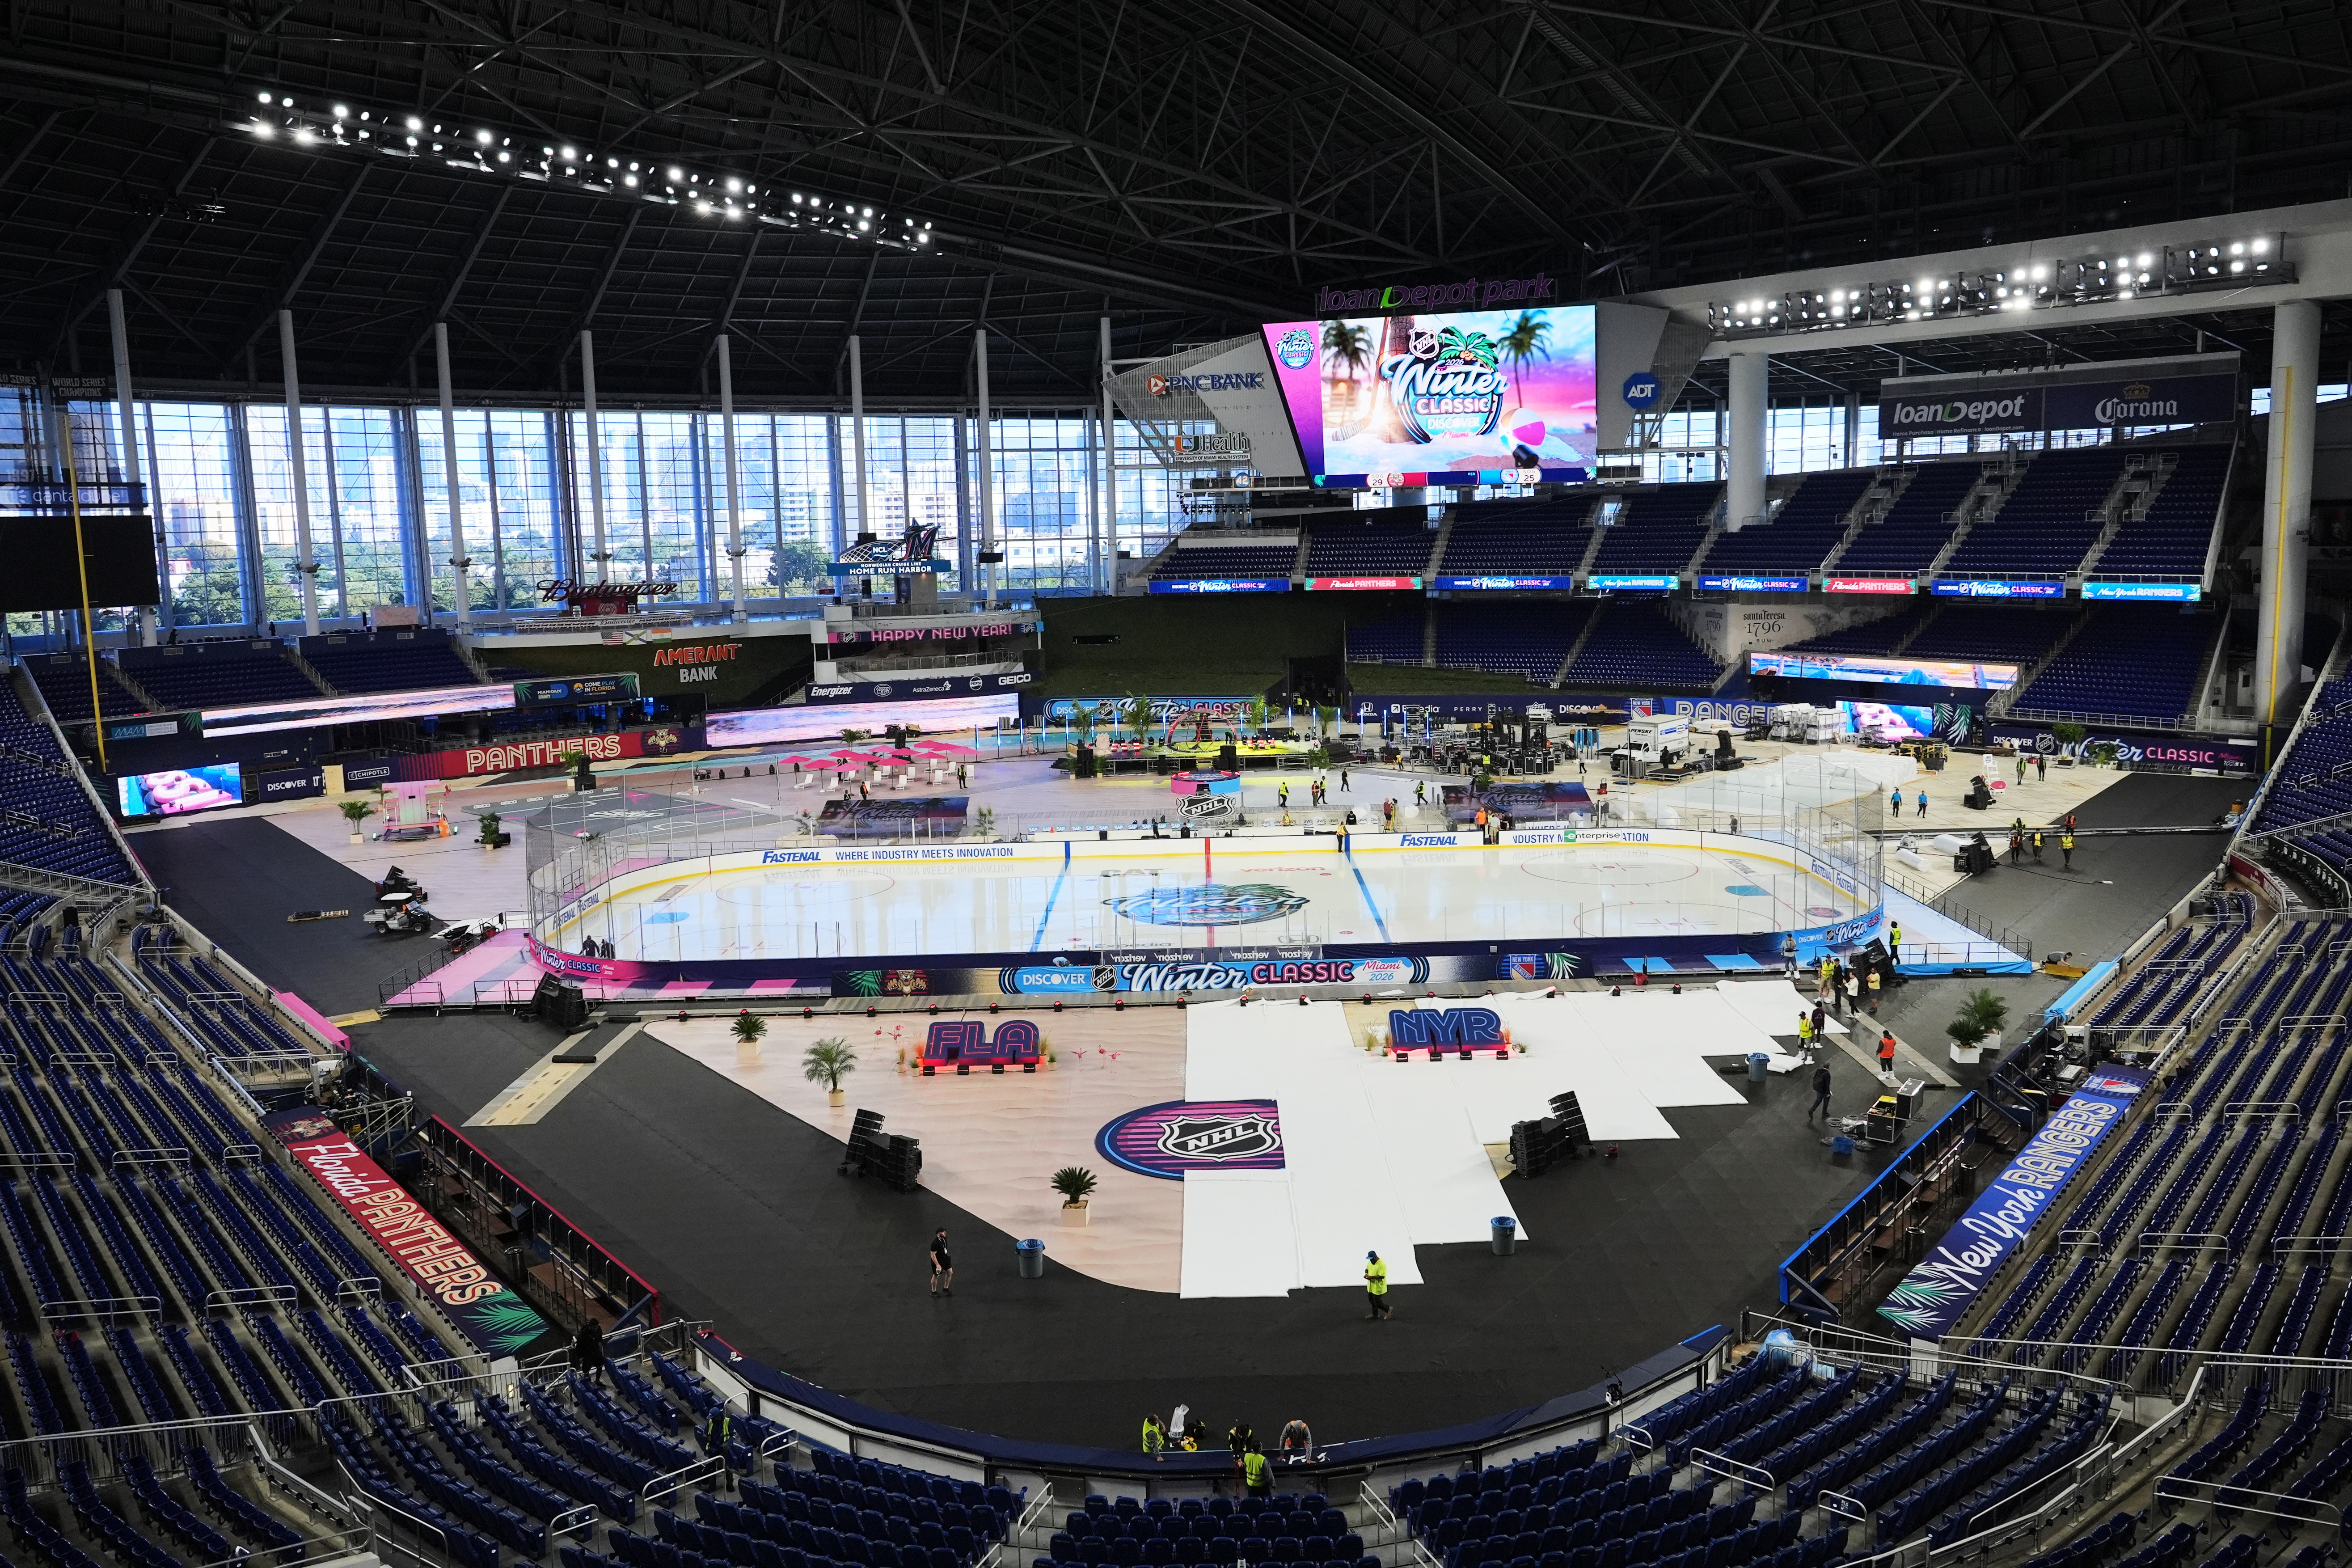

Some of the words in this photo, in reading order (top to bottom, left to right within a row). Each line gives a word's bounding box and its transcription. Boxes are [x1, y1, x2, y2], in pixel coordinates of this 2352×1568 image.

[1320, 278, 1478, 311] loanDepot
[1481, 273, 1553, 308] park
[1274, 339, 1315, 356] Winter
[1415, 335, 1433, 351] NHL
[52, 377, 79, 387] WORLD
[82, 378, 106, 387] SERIES
[1381, 354, 1510, 407] Winter
[59, 388, 102, 397] CHAMPIONS
[1627, 385, 1655, 398] ADT
[1415, 398, 1490, 414] CLASSIC
[1893, 395, 2025, 424] loanDepot
[2095, 398, 2178, 425] Corona
[1426, 417, 1480, 429] DISCOVER
[1442, 431, 1469, 439] Miami
[1236, 475, 1248, 485] 42
[537, 579, 677, 602] Budweiser
[1197, 581, 1232, 592] Winter
[1480, 577, 1515, 589] Winter
[1616, 579, 1631, 587] York
[1729, 578, 1763, 591] Winter
[1832, 581, 1858, 590] Florida
[1858, 582, 1905, 591] PANTHERS
[1969, 582, 2011, 596] Winter
[2097, 587, 2116, 596] New
[2115, 587, 2137, 598] York
[2137, 588, 2183, 596] RANGERS
[870, 629, 927, 642] HAPPY
[932, 627, 967, 639] NEW
[971, 624, 1012, 636] YEAR!
[1746, 620, 1781, 637] 1796
[654, 643, 738, 667] AMERANT
[680, 666, 718, 683] BANK
[811, 686, 853, 697] Energizer
[998, 673, 1031, 685] GEICO
[1101, 706, 1111, 714] NHL
[466, 735, 621, 773] PANTHERS
[2040, 739, 2052, 749] NHL
[2146, 747, 2214, 764] CLASSIC
[358, 769, 388, 778] CHIPOTLE
[267, 779, 307, 791] DISCOVER
[1191, 799, 1223, 815] NHL
[1400, 834, 1458, 846] FASTENAL
[1566, 832, 1620, 841] enterprise
[762, 851, 821, 864] FASTENAL
[836, 851, 869, 861] WHERE
[872, 850, 919, 860] INDUSTRY
[922, 849, 954, 858] MEETS
[957, 848, 1013, 857] INNOVATION
[1101, 869, 1164, 877] CAT
[1812, 859, 1832, 882] FASTENAL
[1102, 896, 1310, 913] Winter
[1151, 906, 1269, 914] CLASSIC
[1798, 934, 1823, 943] DISCOVER
[1835, 920, 1868, 943] Winter
[539, 946, 566, 971] Winter
[567, 959, 601, 973] CLASSIC
[1023, 972, 1085, 985] DISCOVER
[1097, 971, 1112, 985] NHL
[1123, 964, 1246, 992] Winter
[1252, 962, 1353, 981] CLASSIC
[1362, 961, 1402, 972] Miami
[1369, 973, 1394, 981] 2026
[1513, 964, 1532, 980] RANGERS
[1391, 1009, 1502, 1046] NYR
[926, 1020, 1039, 1058] FLA
[1187, 1121, 1256, 1150] NHL
[2001, 1099, 2118, 1189] RANGERS
[1961, 1185, 2045, 1238] York
[293, 1142, 389, 1199] Florida
[350, 1188, 502, 1306] PANTHERS
[1933, 1224, 2003, 1291] New
